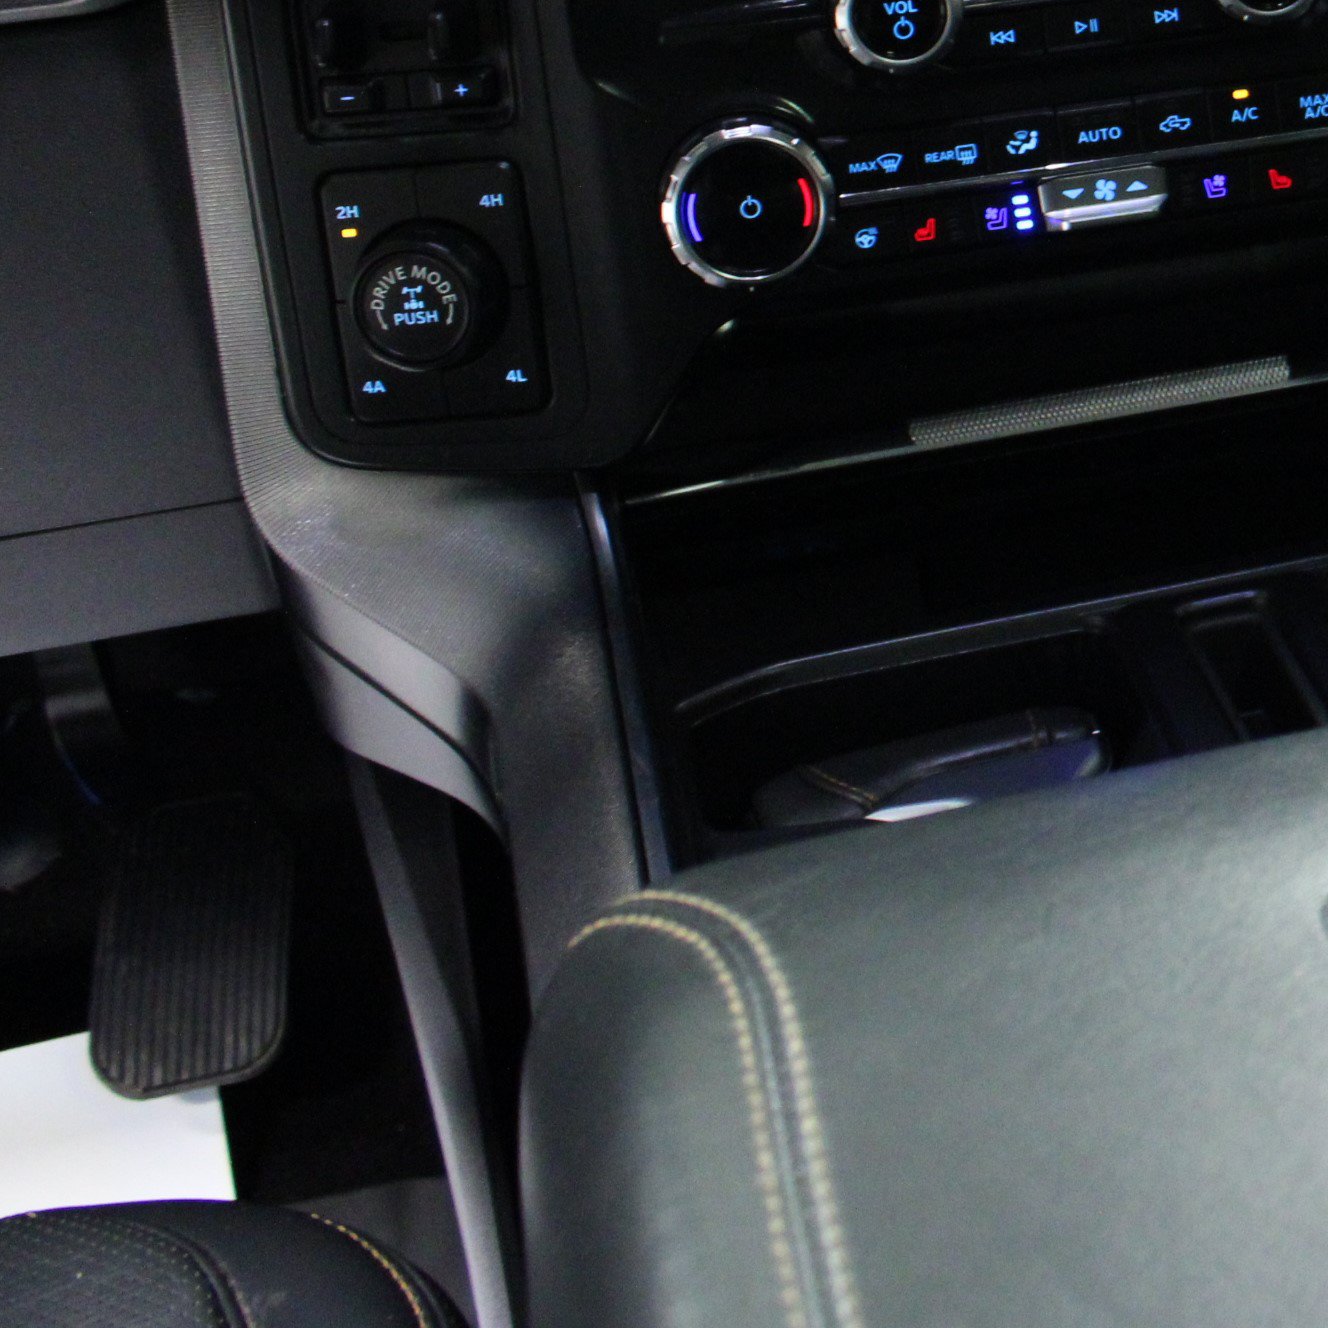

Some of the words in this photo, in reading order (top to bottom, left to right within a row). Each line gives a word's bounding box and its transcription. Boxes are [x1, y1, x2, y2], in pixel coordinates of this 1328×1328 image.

[883, 0, 919, 17] VOL
[1231, 105, 1259, 123] A/C
[1077, 126, 1123, 145] AUTO
[924, 149, 955, 164] REAR
[848, 160, 878, 174] MAX
[479, 193, 504, 208] 4H
[335, 204, 360, 221] 2H
[370, 266, 406, 312] DRIVE
[410, 264, 458, 305] MODE
[393, 309, 440, 327] PUSH
[505, 369, 529, 384] 4L
[362, 379, 388, 395] 4A
